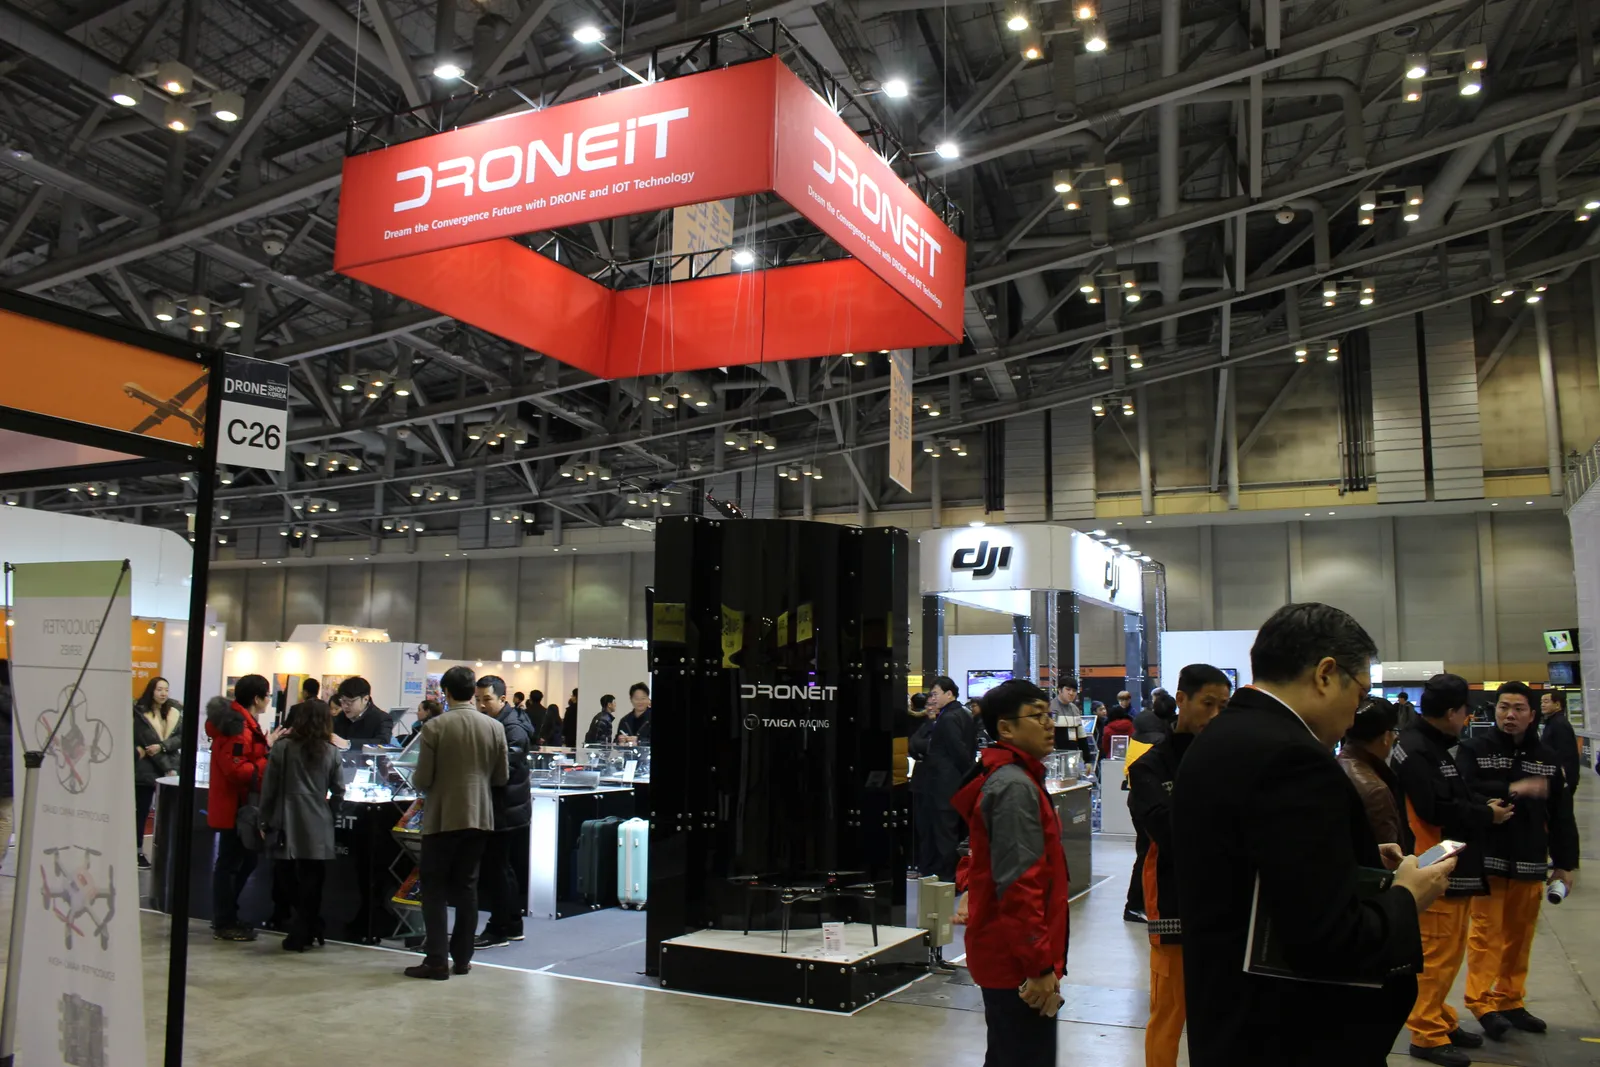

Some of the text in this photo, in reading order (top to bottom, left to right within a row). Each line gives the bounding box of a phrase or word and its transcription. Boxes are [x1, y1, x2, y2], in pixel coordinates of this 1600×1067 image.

[384, 171, 695, 240] Dream the Convergence Future with DRONE and IOT Technology
[807, 185, 826, 208] Dream
[826, 201, 836, 216] the
[836, 209, 867, 242] Convergence
[866, 235, 882, 255] Future
[881, 250, 892, 264] with
[891, 257, 907, 277] DRONE
[907, 271, 915, 284] and
[922, 284, 943, 309] Technology
[224, 377, 267, 396] DRONE
[267, 384, 287, 394] SHOW
[267, 391, 287, 400] KOREA
[227, 418, 281, 450] C26
[762, 718, 797, 728] TAIGA
[799, 719, 830, 728] RACING
